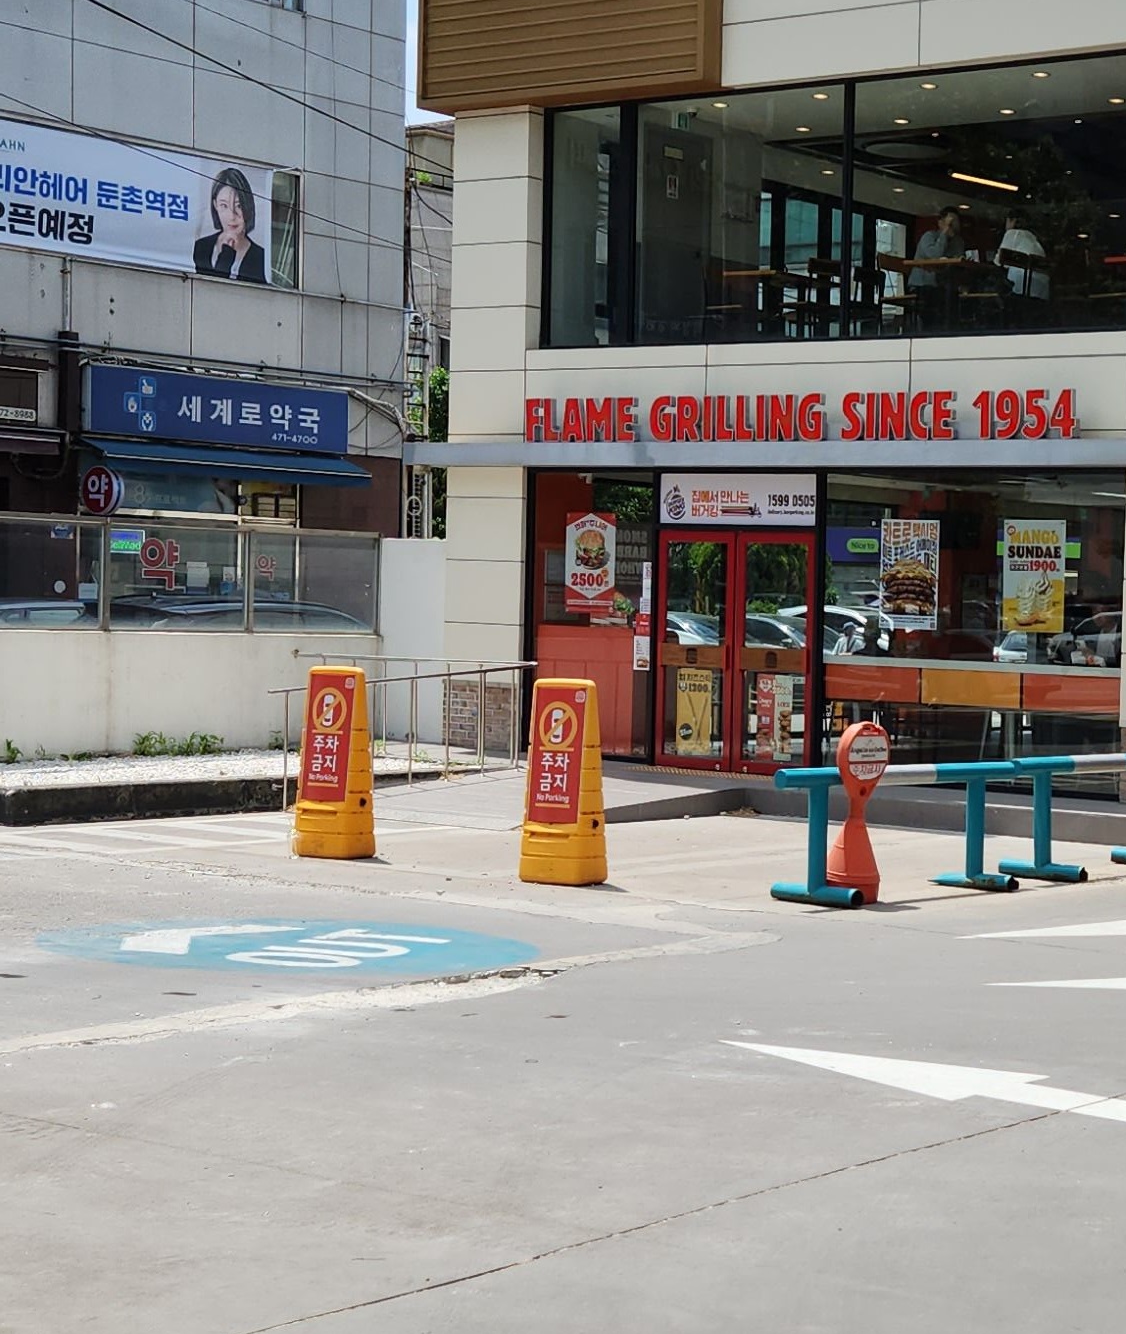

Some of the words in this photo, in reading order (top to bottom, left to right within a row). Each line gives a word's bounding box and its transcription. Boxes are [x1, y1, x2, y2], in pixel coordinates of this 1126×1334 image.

[97, 180, 189, 222] 둔촌역점
[177, 395, 320, 434] 세계로약국
[525, 397, 636, 442] FLAME
[649, 394, 824, 441] GRILLING
[840, 390, 957, 441] SINCE
[972, 388, 1078, 440] 1954
[271, 433, 318, 445] 471-4700
[87, 474, 109, 508] 약
[691, 490, 719, 503] 집에서
[720, 490, 749, 503] 만나는
[768, 494, 789, 507] 1599
[792, 495, 815, 507] 0505
[691, 504, 719, 517] 버거킹
[1010, 529, 1060, 544] MANGO
[1008, 545, 1062, 559] SUNDAE
[139, 537, 180, 591] 약
[256, 554, 277, 581] 약
[1029, 560, 1056, 572] 1900
[571, 572, 604, 587] 2500
[312, 734, 340, 754] 주차
[311, 753, 337, 773] 금지
[540, 752, 570, 773] 주차
[316, 773, 339, 784] Parking
[539, 772, 568, 793] 금지
[536, 793, 544, 802] No
[544, 793, 570, 804] Parking
